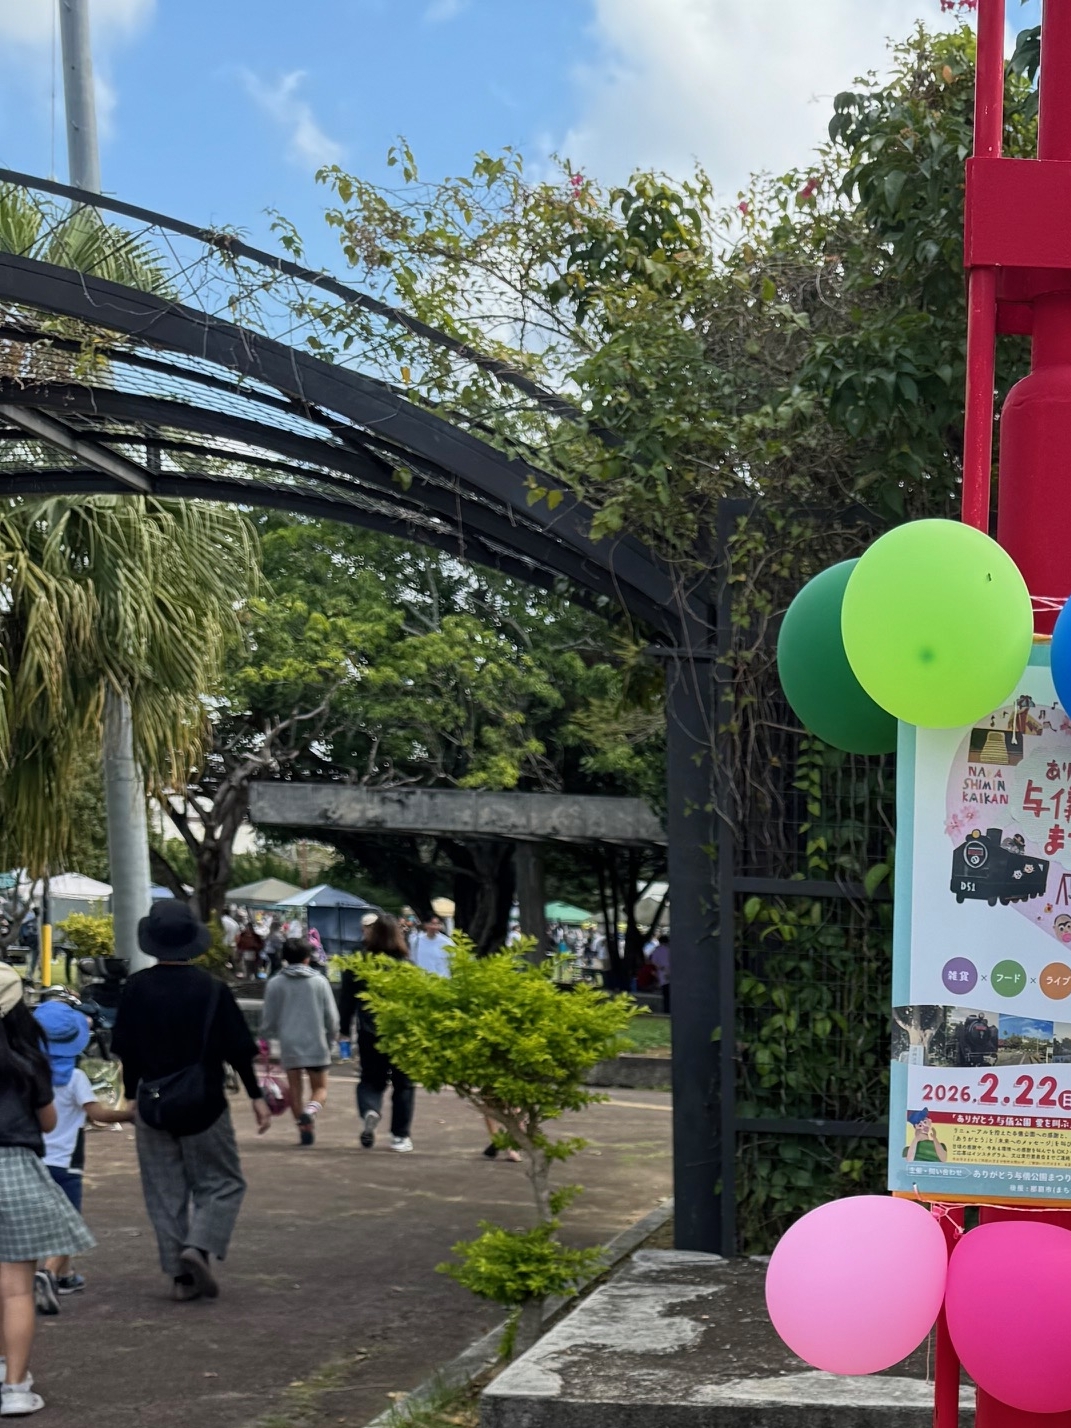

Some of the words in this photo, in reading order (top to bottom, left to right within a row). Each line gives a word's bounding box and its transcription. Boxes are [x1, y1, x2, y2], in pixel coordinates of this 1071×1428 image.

[962, 777, 1006, 792] SHIMIN
[962, 791, 1009, 804] KAIKAN
[960, 881, 976, 892] D51
[947, 970, 969, 982] 雑貨
[996, 973, 1021, 983] フード
[1045, 976, 1071, 986] ライブ
[922, 1073, 1058, 1108] 2026.2.22
